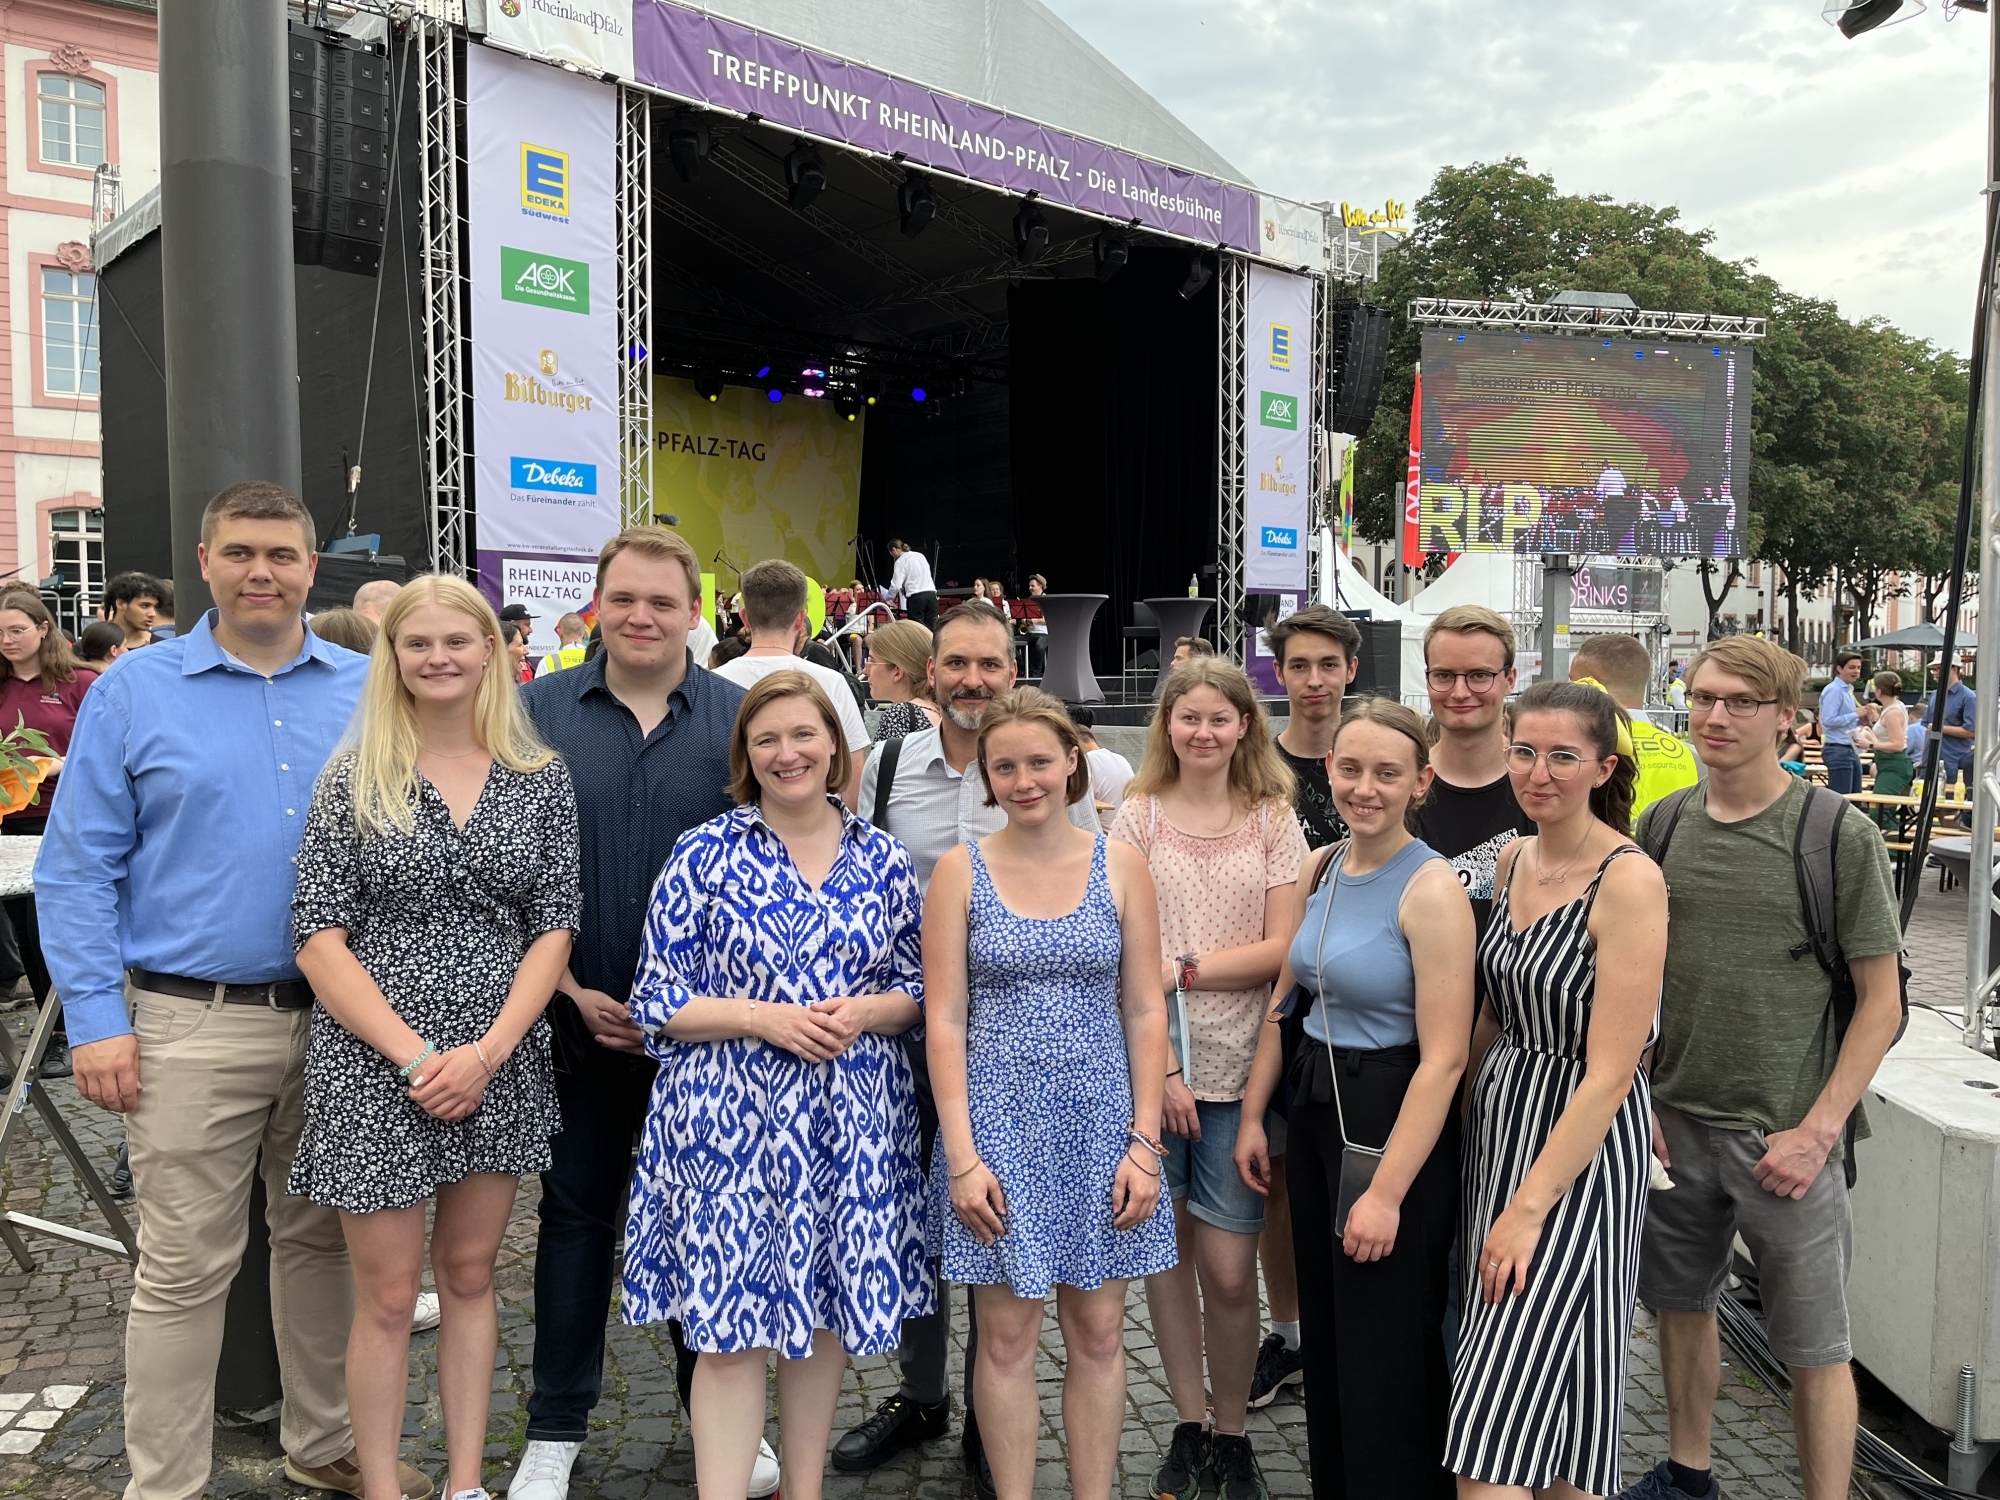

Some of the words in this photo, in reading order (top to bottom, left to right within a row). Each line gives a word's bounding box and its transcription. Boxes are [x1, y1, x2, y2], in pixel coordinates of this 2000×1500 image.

[708, 49, 871, 121] TREFFPUNKT
[880, 103, 1071, 181] RHEINLAND-PFALZ
[1088, 168, 1116, 194] Die
[1122, 178, 1222, 225] Landesbühne
[527, 194, 565, 210] EDEKA
[521, 208, 570, 225] Südwest
[517, 262, 575, 294] AOK
[515, 284, 525, 292] Die
[504, 372, 593, 413] Bitburger
[1267, 399, 1291, 418] AOK
[522, 463, 584, 488] Debeka
[1260, 472, 1297, 496] Bitburger
[510, 493, 525, 502] Das
[526, 494, 577, 506] Füreinander
[509, 568, 596, 583] RHEINLAND-
[509, 585, 582, 599] PFALZ-TAG
